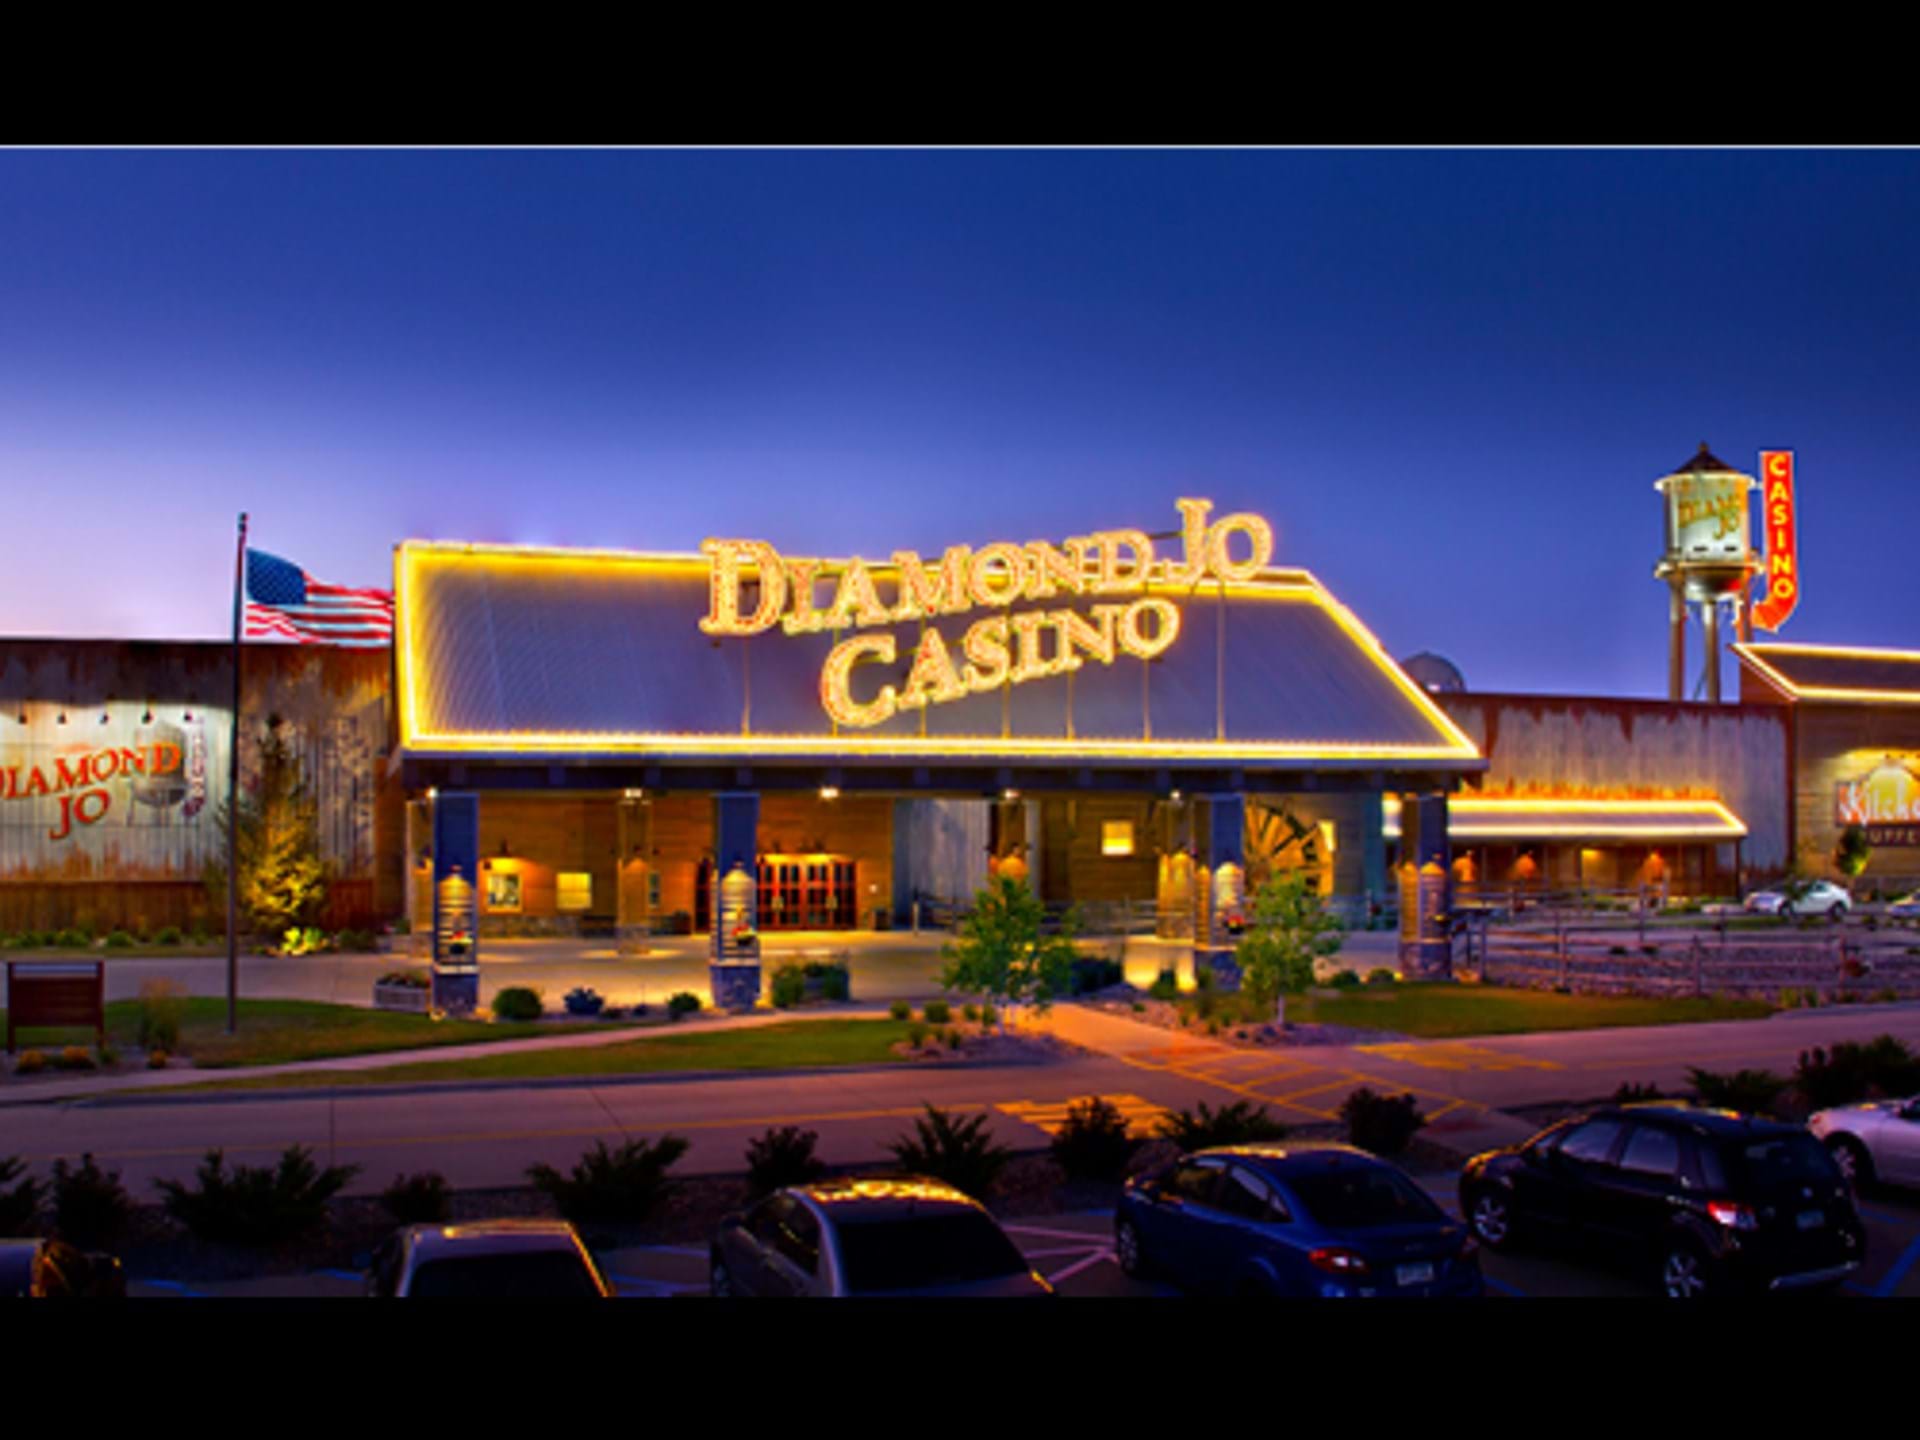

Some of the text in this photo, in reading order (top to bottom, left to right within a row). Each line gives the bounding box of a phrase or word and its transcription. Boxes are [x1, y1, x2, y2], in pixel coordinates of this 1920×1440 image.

[697, 496, 1273, 637] DIAMOND JO
[1768, 454, 1795, 599] CASINO
[818, 596, 1182, 729] CASINO
[0, 740, 182, 800] IAMOND
[48, 788, 112, 841] JO
